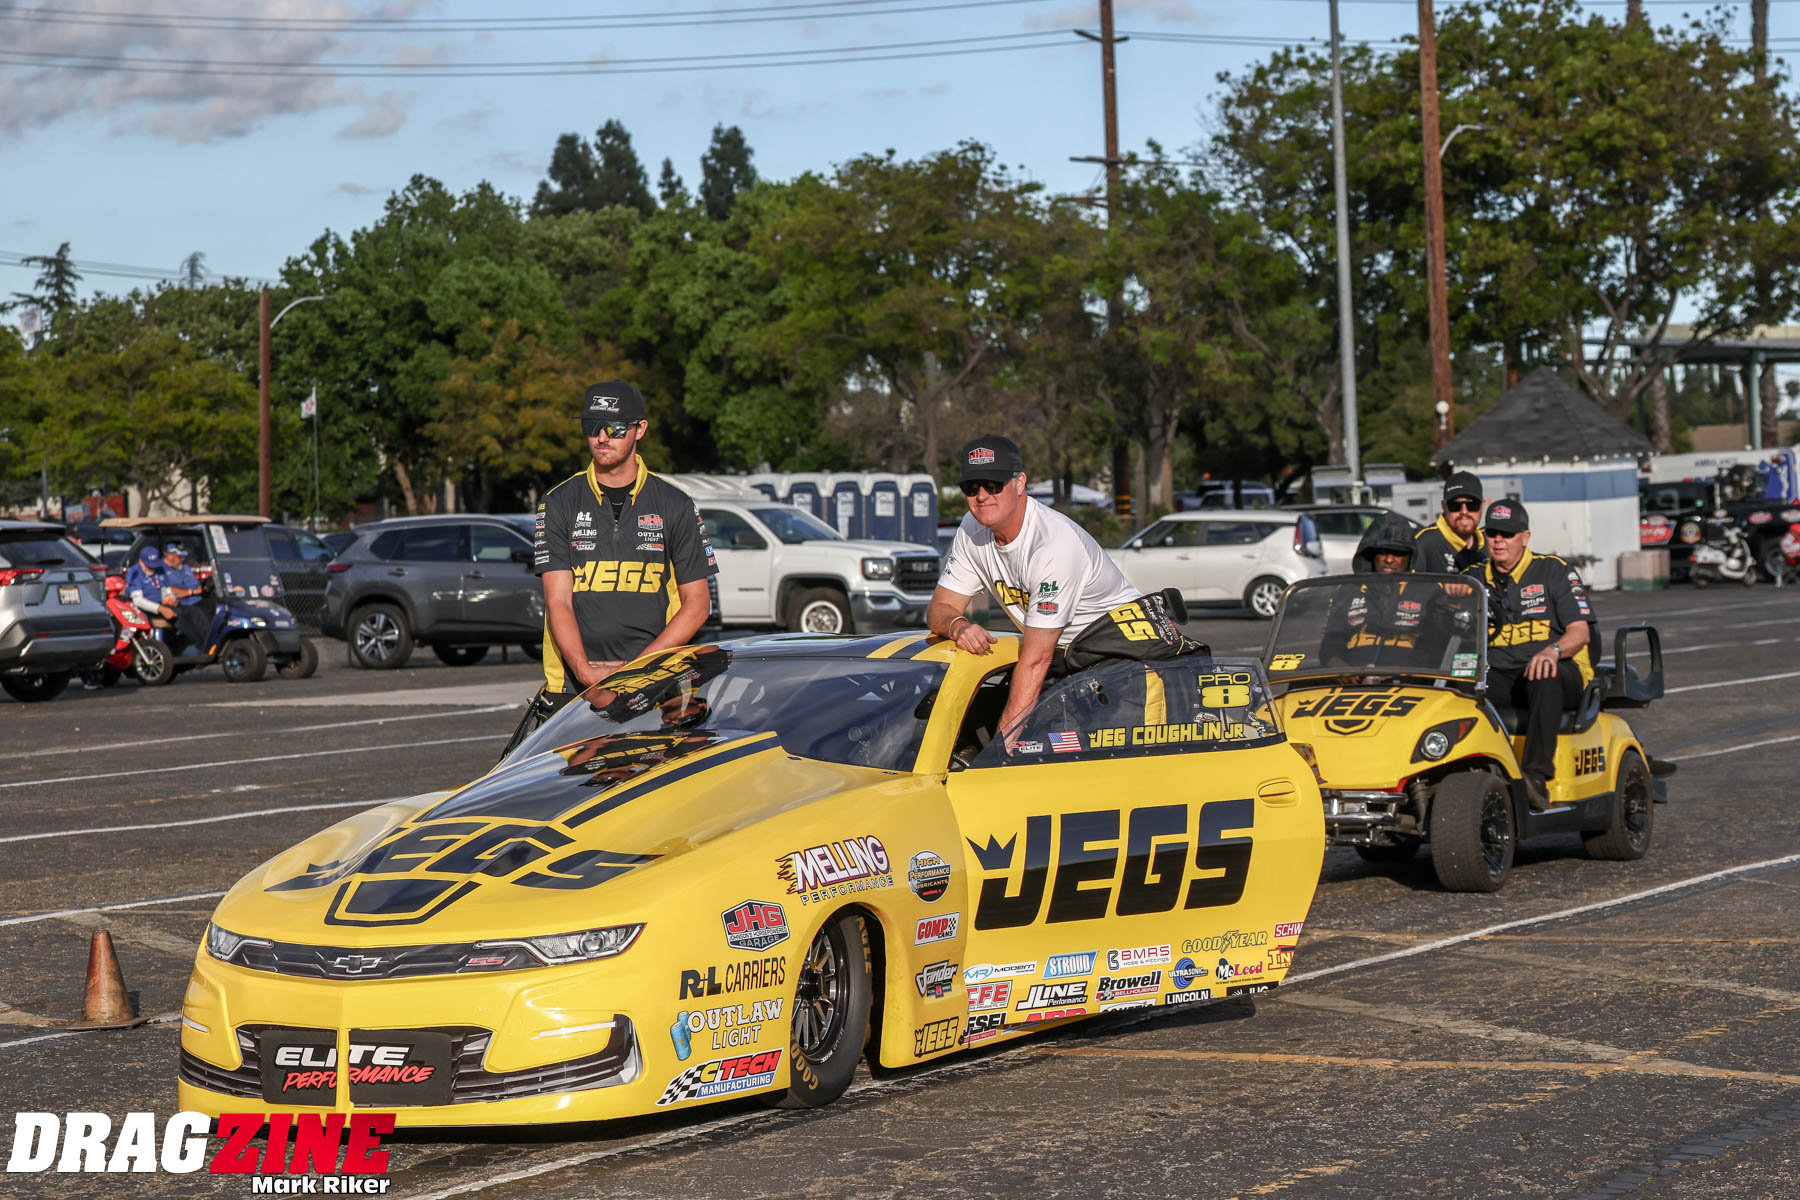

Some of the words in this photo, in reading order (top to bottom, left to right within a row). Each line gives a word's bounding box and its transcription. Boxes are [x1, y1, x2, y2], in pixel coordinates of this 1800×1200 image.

[572, 561, 664, 593] JEGS
[1040, 581, 1059, 592] R+L
[1268, 659, 1301, 671] 8
[1274, 653, 1306, 661] PRO
[1198, 672, 1251, 687] PRO
[1201, 685, 1250, 708] 8
[1291, 694, 1426, 719] JEGS
[1089, 727, 1126, 748] JEG
[1131, 721, 1221, 745] COUGHLIN
[1223, 723, 1247, 739] JR
[1575, 746, 1606, 776] JEGS
[265, 822, 666, 890] JEGS
[795, 835, 890, 893] MELLING
[917, 857, 940, 867] HIGH
[974, 798, 1255, 931] JEGS
[800, 875, 894, 906] PERFORMANCE
[727, 905, 784, 933] JHG
[918, 918, 948, 940] COMP
[739, 935, 780, 947] GARAGE
[938, 930, 953, 938] CAMS
[1182, 930, 1268, 954] GOODYEAR
[1121, 946, 1170, 960] BMRS
[725, 956, 786, 993] CARRIERS
[1049, 954, 1091, 976] STROUD
[1216, 961, 1263, 979] McLeod
[1099, 970, 1162, 991] Browell
[1047, 997, 1087, 1006] Performance
[1166, 991, 1209, 1004] LINCOLN
[687, 998, 784, 1033] OUTLAW
[712, 1026, 762, 1050] LIGHT
[914, 1017, 959, 1056] JEGS
[275, 1045, 410, 1068] ELITE
[700, 1076, 771, 1097] MANUFACTURING
